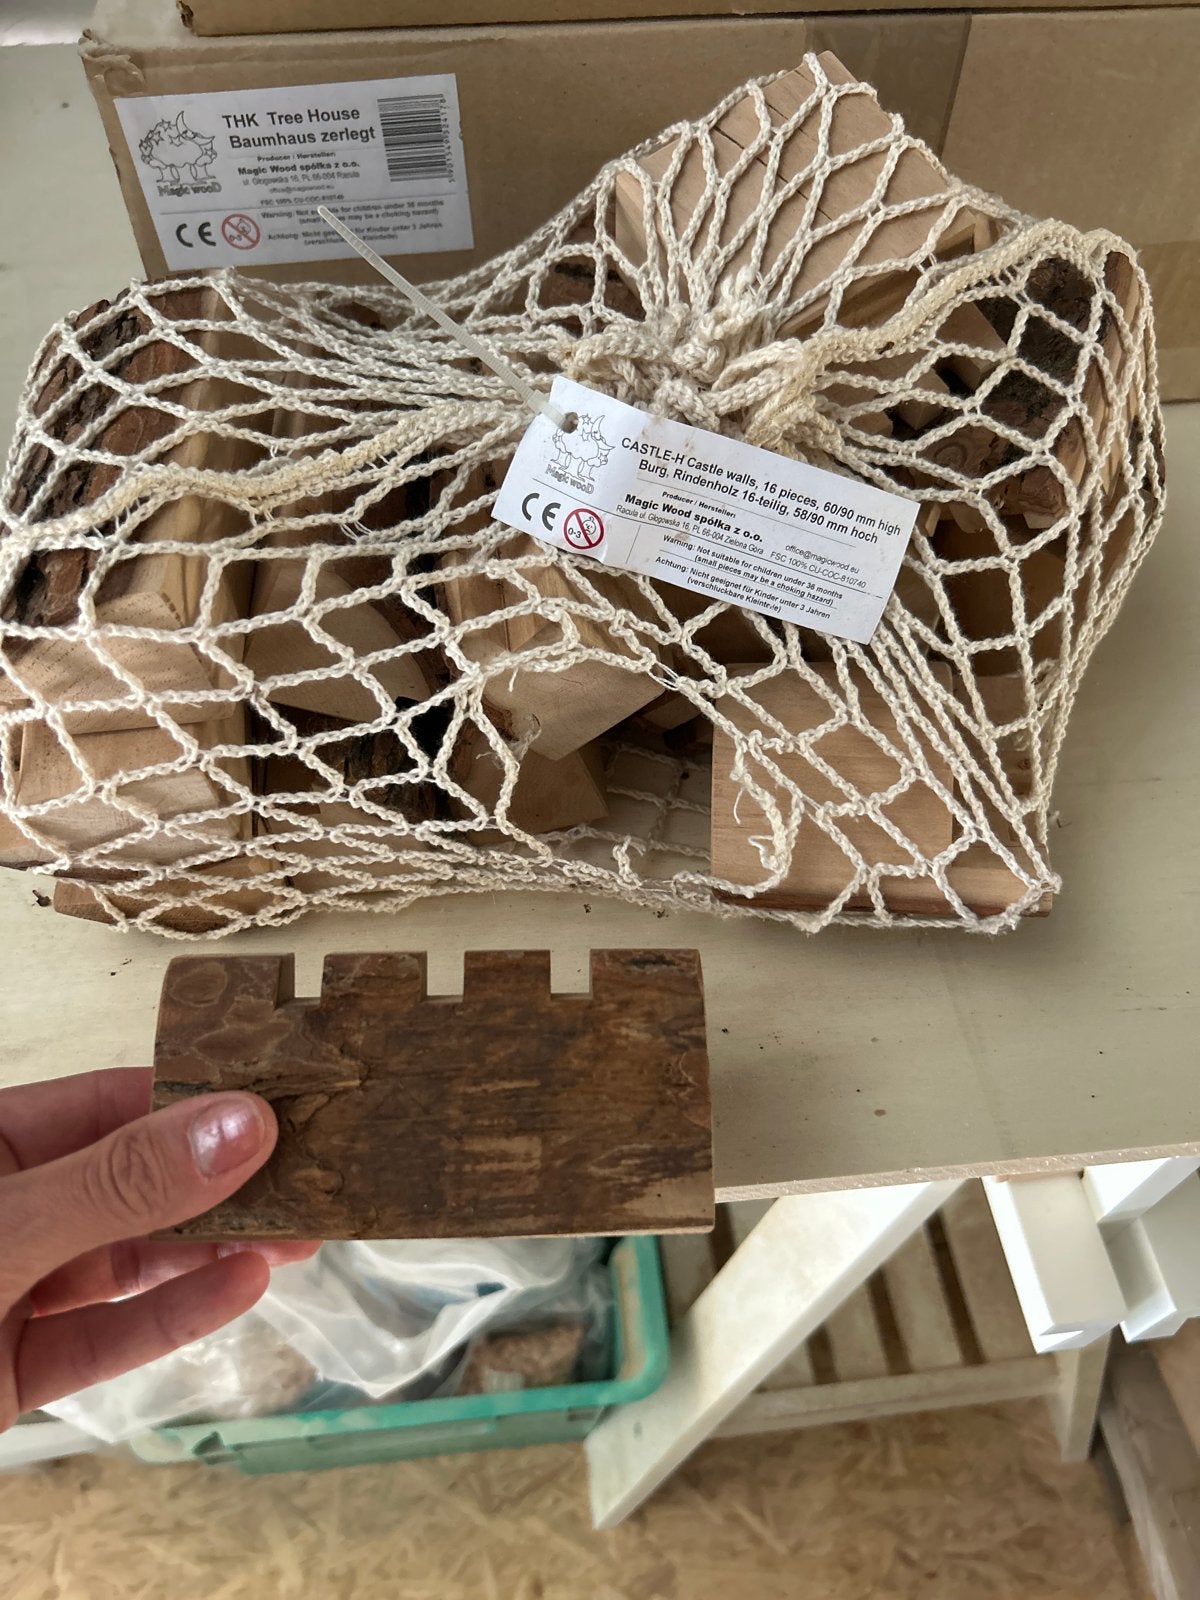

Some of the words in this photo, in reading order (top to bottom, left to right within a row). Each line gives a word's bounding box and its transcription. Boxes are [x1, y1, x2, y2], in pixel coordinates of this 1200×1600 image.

[221, 113, 259, 128] THK
[266, 111, 303, 125] Tree
[307, 108, 360, 122] House
[229, 132, 316, 148] Baumhaus
[320, 126, 376, 143] zerlegt
[237, 166, 267, 176] Magic
[269, 164, 297, 173] Wood
[621, 437, 685, 465] CASTLE-H
[687, 457, 723, 476] Castle
[726, 470, 758, 490] walls,
[764, 481, 777, 494] 16
[777, 488, 819, 510] pieces,
[823, 501, 854, 520] 60/90
[855, 514, 876, 527] mm
[877, 519, 901, 536] high
[638, 458, 669, 478] Burg,
[672, 468, 739, 497] Rindenholz
[742, 489, 789, 516] 16-teilig,
[793, 507, 824, 525] 58/90
[826, 520, 848, 534] mm
[850, 526, 878, 543] hoch
[662, 491, 693, 504] Producer
[698, 501, 736, 518] Hersteller:
[565, 527, 584, 538] 0-3
[615, 504, 638, 517] Racula
[701, 527, 724, 541] 66-004
[723, 535, 747, 549] Zielona
[625, 493, 659, 510] Magic
[662, 503, 692, 518] Wood
[693, 514, 731, 531] spółka
[733, 527, 741, 535] z
[743, 530, 762, 542] o.o.
[663, 534, 695, 551] Warning:
[696, 545, 710, 555] Not
[711, 551, 740, 565] suitable
[740, 560, 752, 569] for
[752, 565, 782, 579] children
[783, 575, 805, 586] under
[805, 582, 815, 590] 36
[815, 586, 843, 599] months
[694, 554, 718, 567] (small
[717, 563, 741, 577] pieces
[741, 571, 759, 582] may
[759, 575, 769, 584] be
[775, 582, 806, 598] choking
[806, 591, 833, 607] hazard)
[769, 551, 787, 562] FSC
[788, 557, 807, 569] 100%
[808, 564, 866, 588] CU-COC-810740
[655, 556, 688, 573] Achtung:
[689, 567, 710, 579] Nicht
[710, 575, 742, 590] geeignet
[742, 585, 754, 593] für
[753, 588, 778, 601] Kinder
[779, 598, 799, 608] unter
[799, 603, 805, 611] 3
[805, 606, 830, 619] Jahren
[687, 576, 744, 600] (verschluckbare
